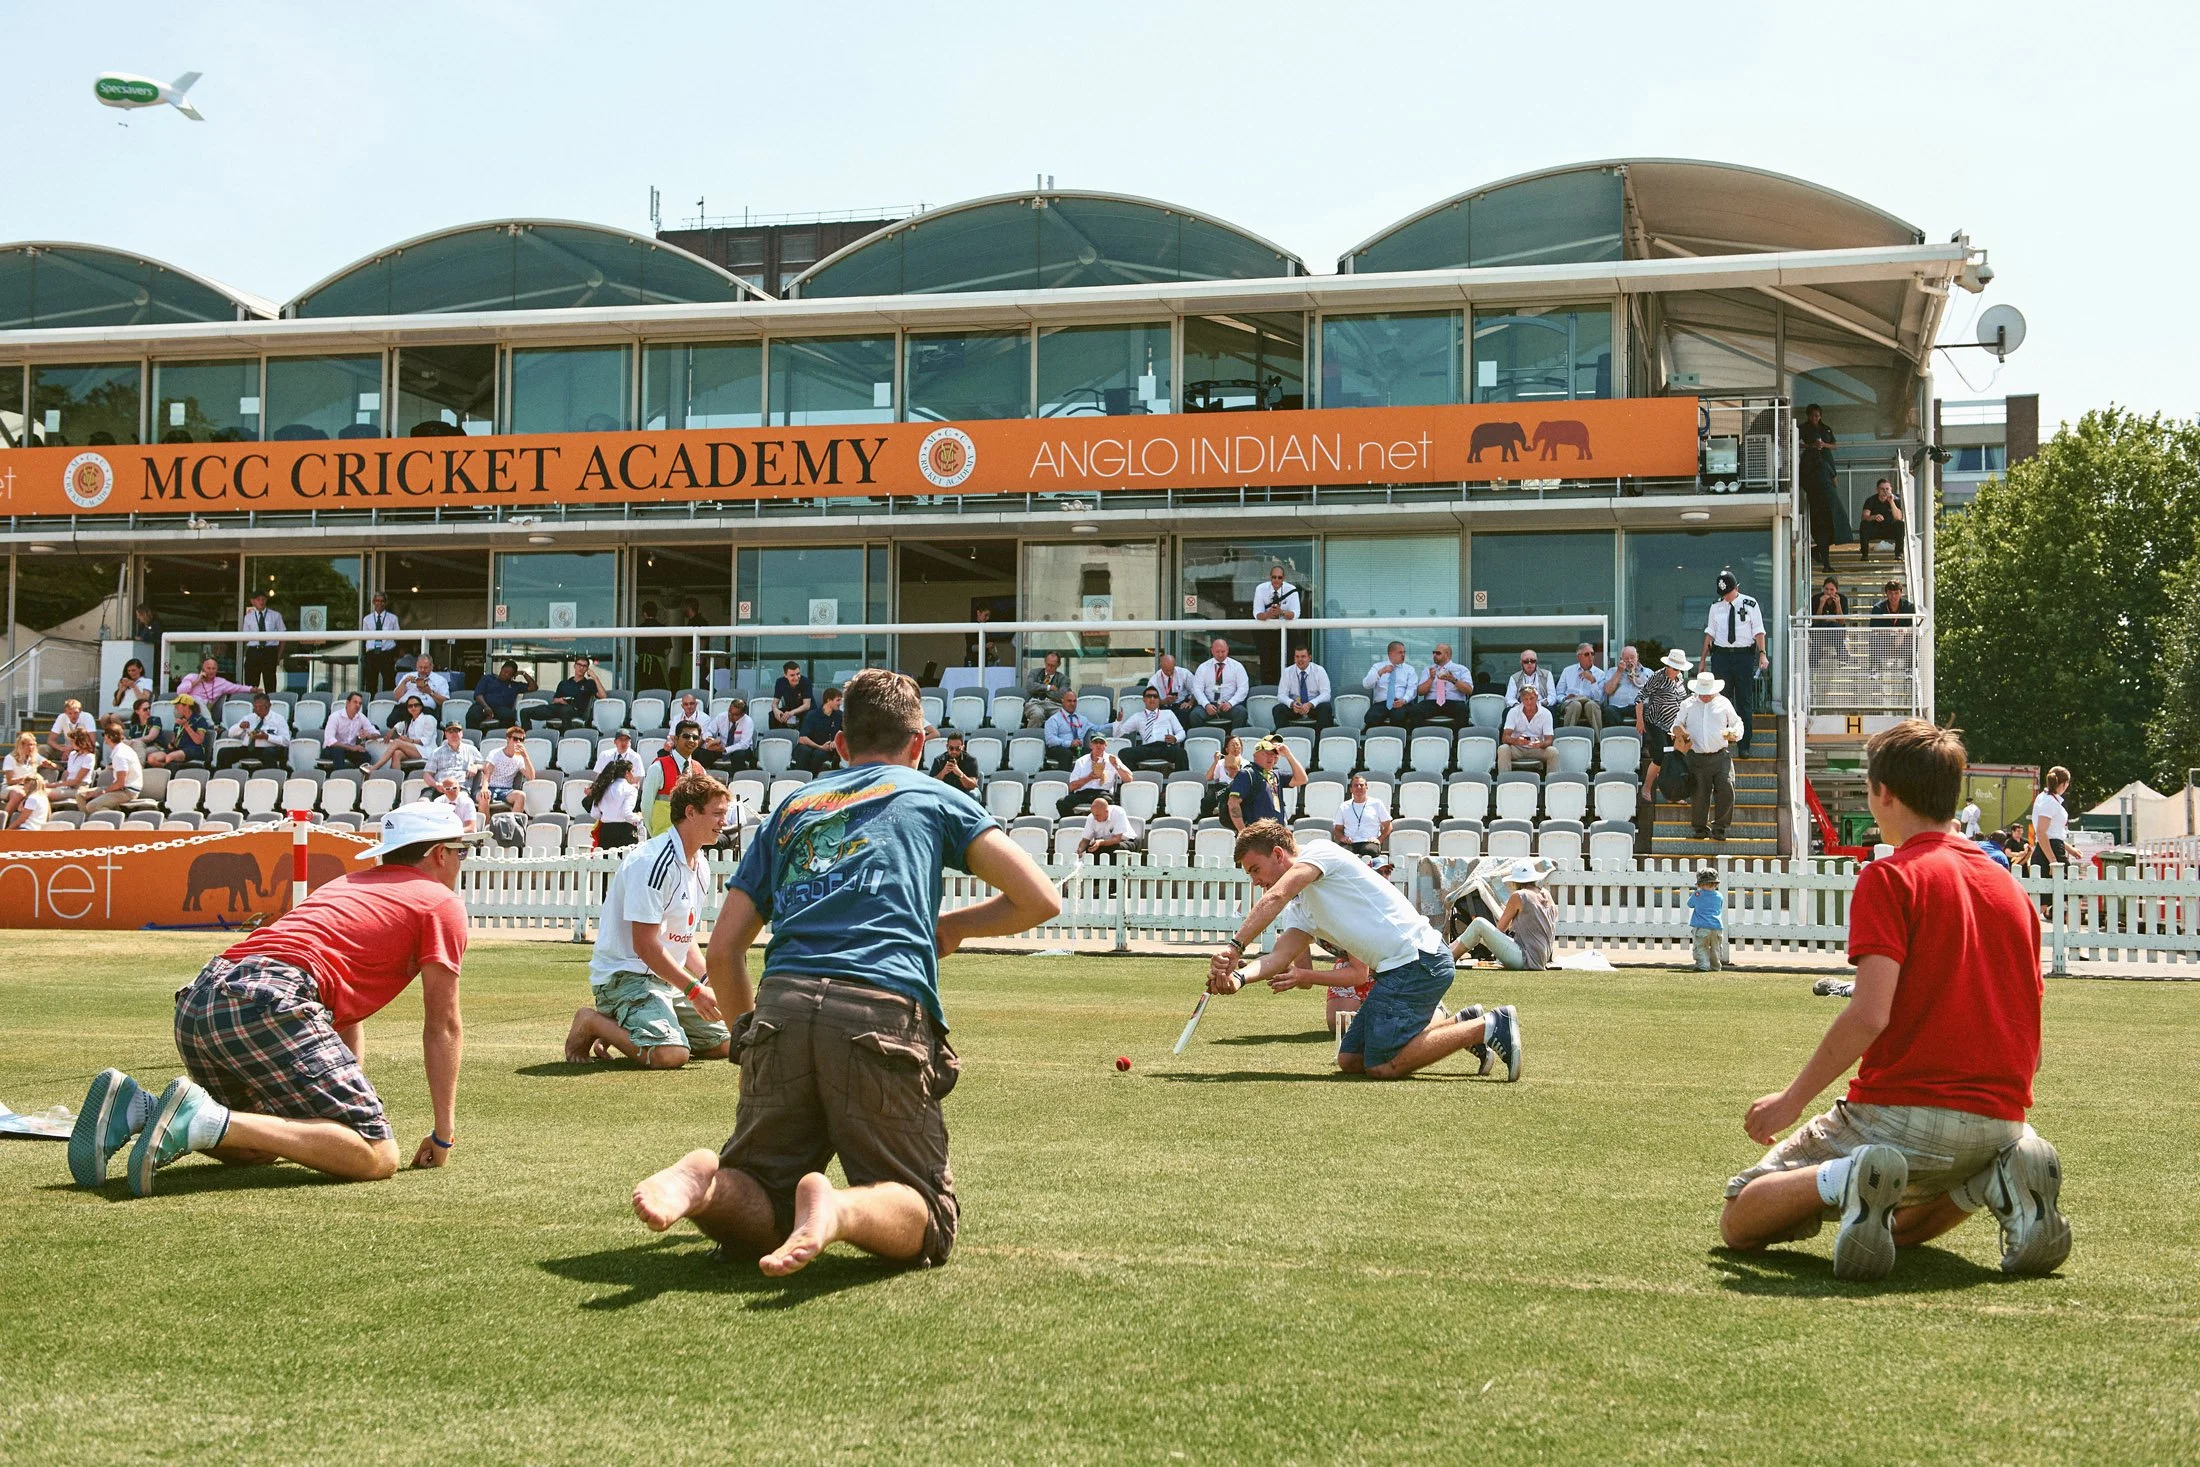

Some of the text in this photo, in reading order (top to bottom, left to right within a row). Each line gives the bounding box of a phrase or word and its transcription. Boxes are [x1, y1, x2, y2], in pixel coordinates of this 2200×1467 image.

[100, 82, 153, 97] Specsavers
[140, 437, 888, 500] MCC CRICKET ACADEMY
[1029, 437, 1179, 479] ANGLO
[1847, 716, 1861, 734] H
